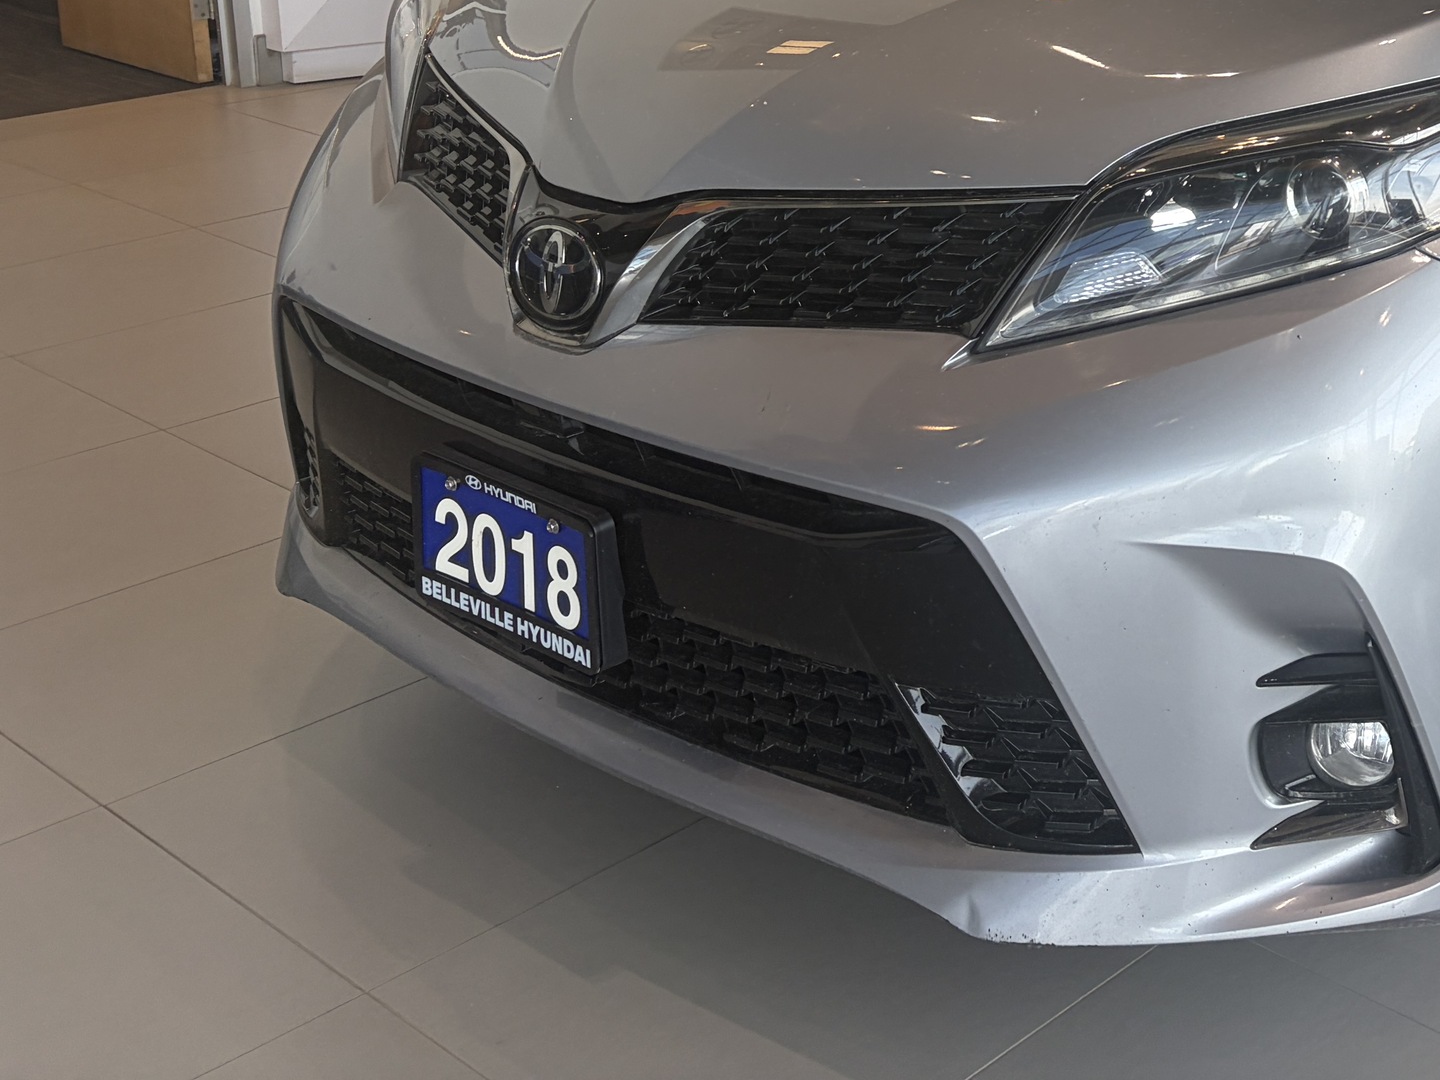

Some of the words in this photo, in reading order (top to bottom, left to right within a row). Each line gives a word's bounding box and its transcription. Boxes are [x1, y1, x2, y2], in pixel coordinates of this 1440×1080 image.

[484, 482, 537, 514] HYUNDAI
[434, 498, 581, 631] 2018
[421, 575, 514, 632] BELLEVILLE
[516, 617, 592, 668] HYUNDAI
